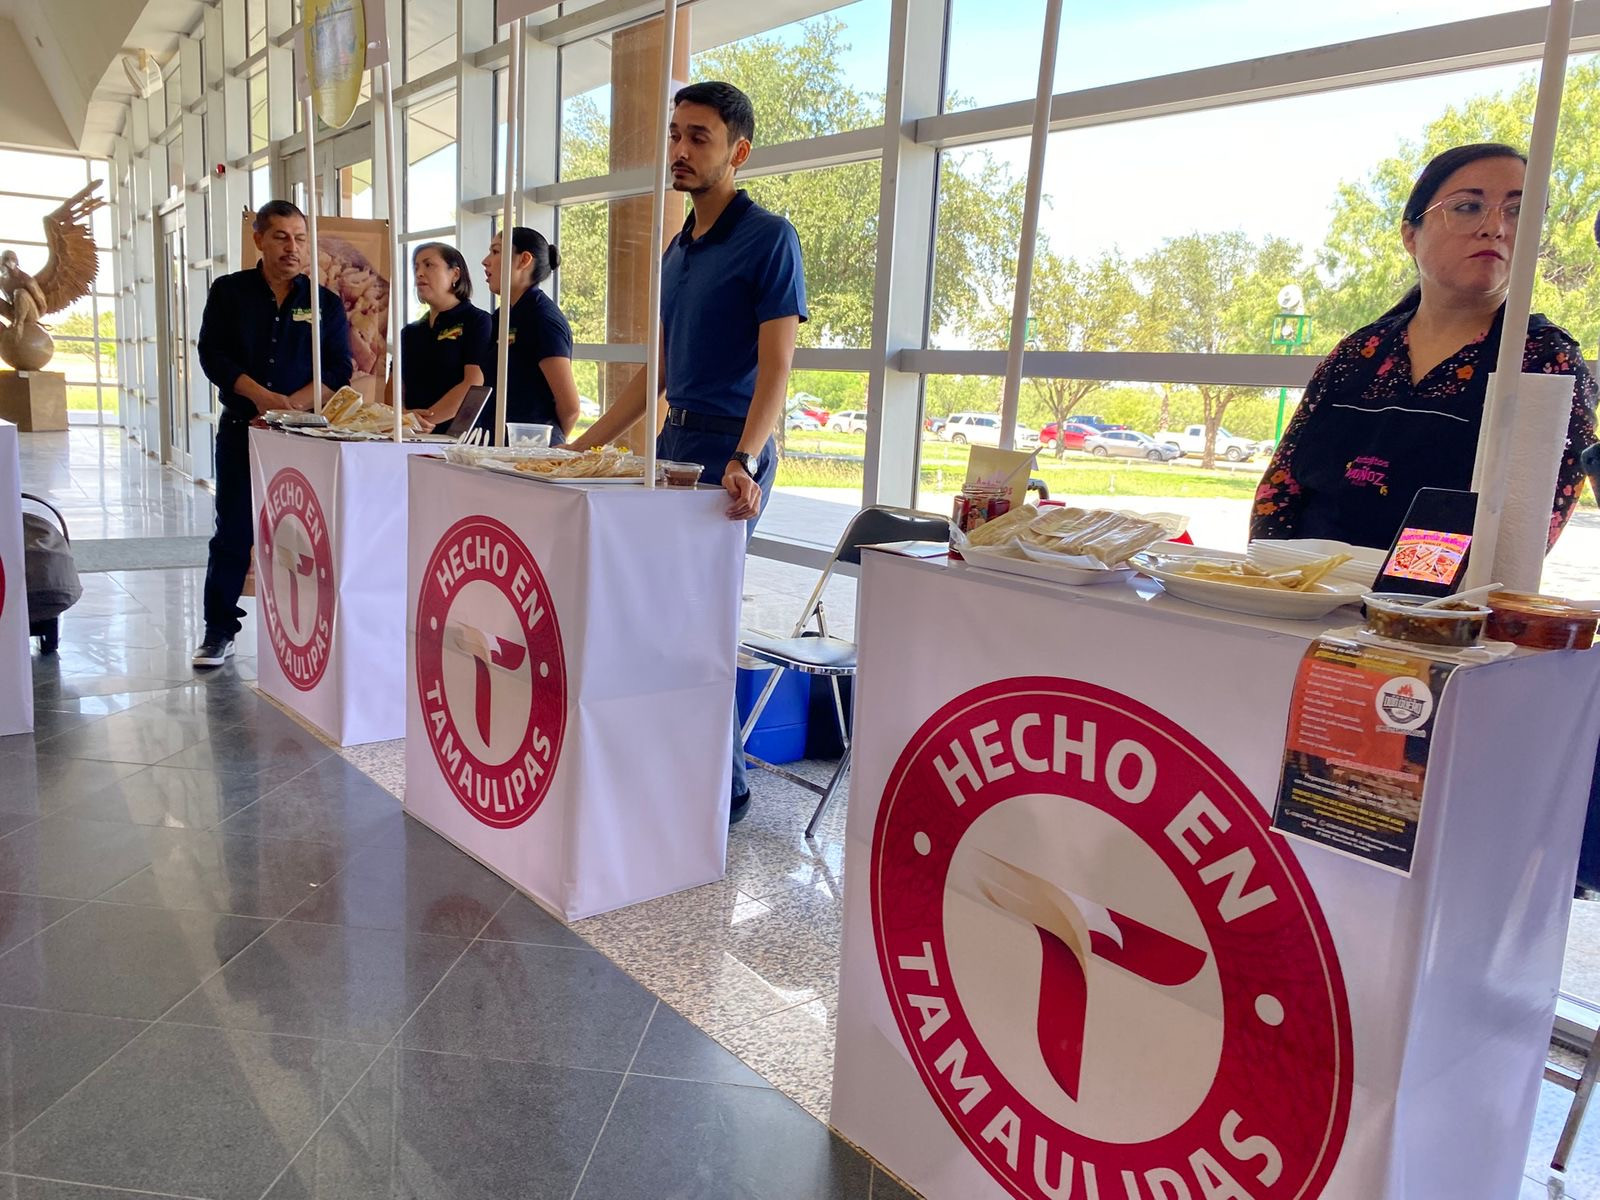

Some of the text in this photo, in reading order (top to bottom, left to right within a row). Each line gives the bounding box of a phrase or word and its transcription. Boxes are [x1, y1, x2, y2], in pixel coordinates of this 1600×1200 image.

[305, 500, 322, 546] EN
[1344, 466, 1385, 486] MUÑOZ
[436, 535, 544, 629] HECHO EN
[427, 680, 551, 812] TAMAULIPAS
[932, 713, 1278, 923] HECHO EN
